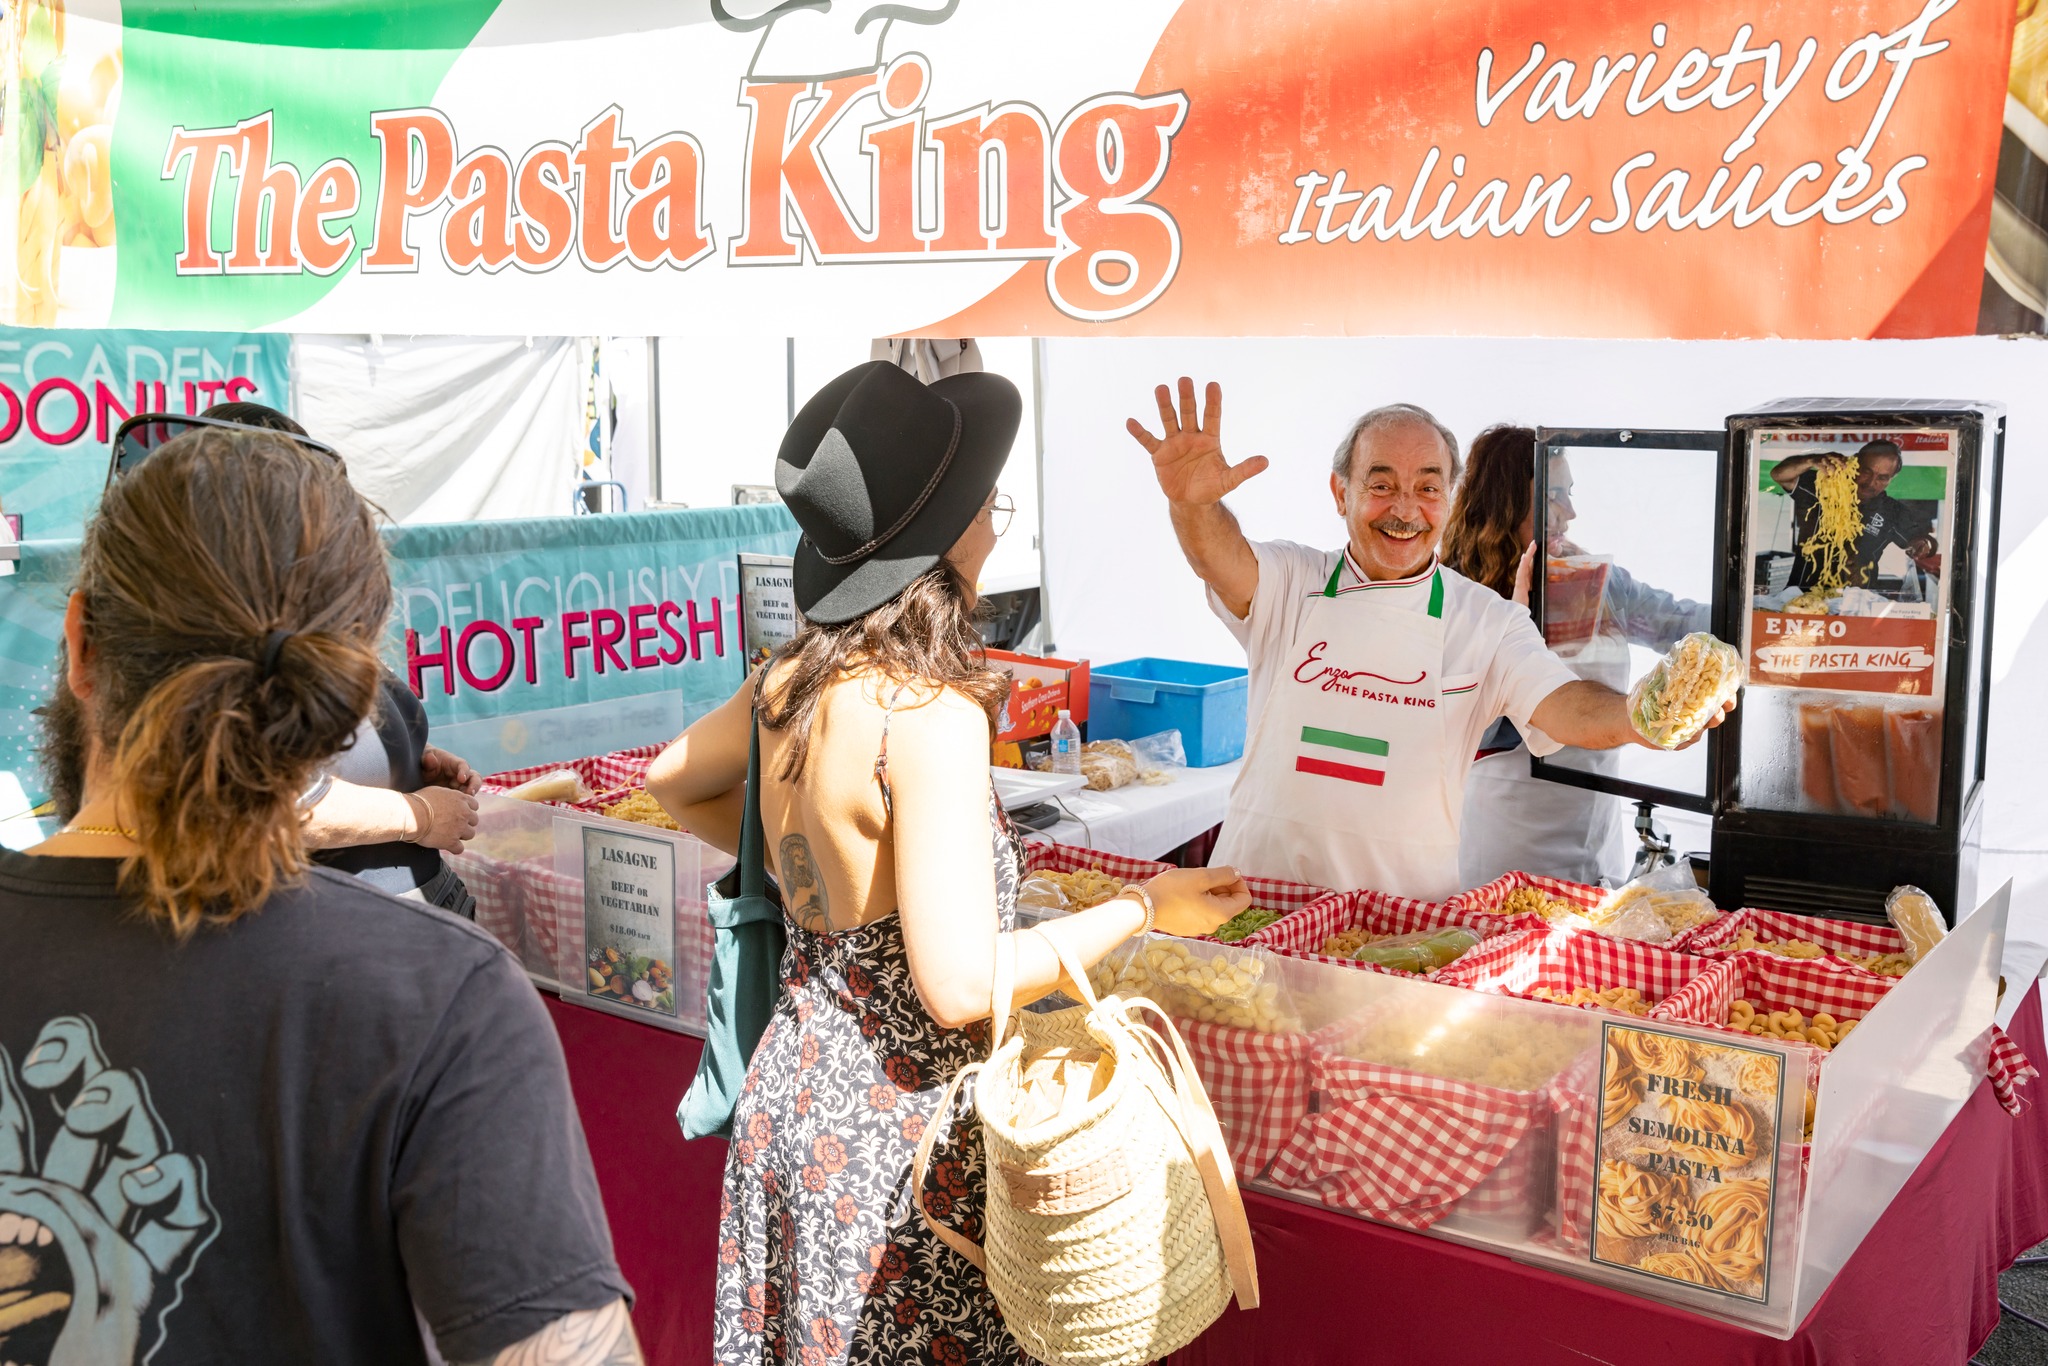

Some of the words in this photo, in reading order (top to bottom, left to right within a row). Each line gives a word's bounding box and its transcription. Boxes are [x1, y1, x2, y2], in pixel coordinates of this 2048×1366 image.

[1475, 23, 1817, 164] Variety
[1824, 0, 1958, 173] of
[160, 109, 361, 277] The
[360, 102, 717, 275] Pasta
[727, 50, 1191, 322] King
[1277, 146, 1592, 245] Italian
[1589, 150, 1928, 234] Sauces
[402, 563, 704, 646] DELICIOUSLY
[762, 599, 780, 608] BEEF
[1765, 617, 1847, 638] ENZO
[405, 614, 543, 699] HOT
[562, 596, 724, 679] FRESH
[1770, 653, 1801, 667] THE
[1809, 652, 1859, 667] PASTA
[1865, 650, 1912, 668] KING
[1334, 683, 1358, 697] THE
[1362, 689, 1399, 705] PASTA
[1403, 696, 1436, 708] KING
[601, 847, 658, 870] LASAGNE
[611, 880, 635, 895] BEEF
[637, 887, 648, 898] OR
[600, 895, 660, 917] VEGETARIAN
[610, 923, 637, 938] $18.00
[1647, 1073, 1733, 1107] FRESH
[1628, 1117, 1746, 1156] SEMOLINA
[1648, 1152, 1722, 1184] PASTA
[1650, 1201, 1713, 1232] $7.50
[1659, 1231, 1679, 1246] PER
[1681, 1235, 1701, 1249] BAG
